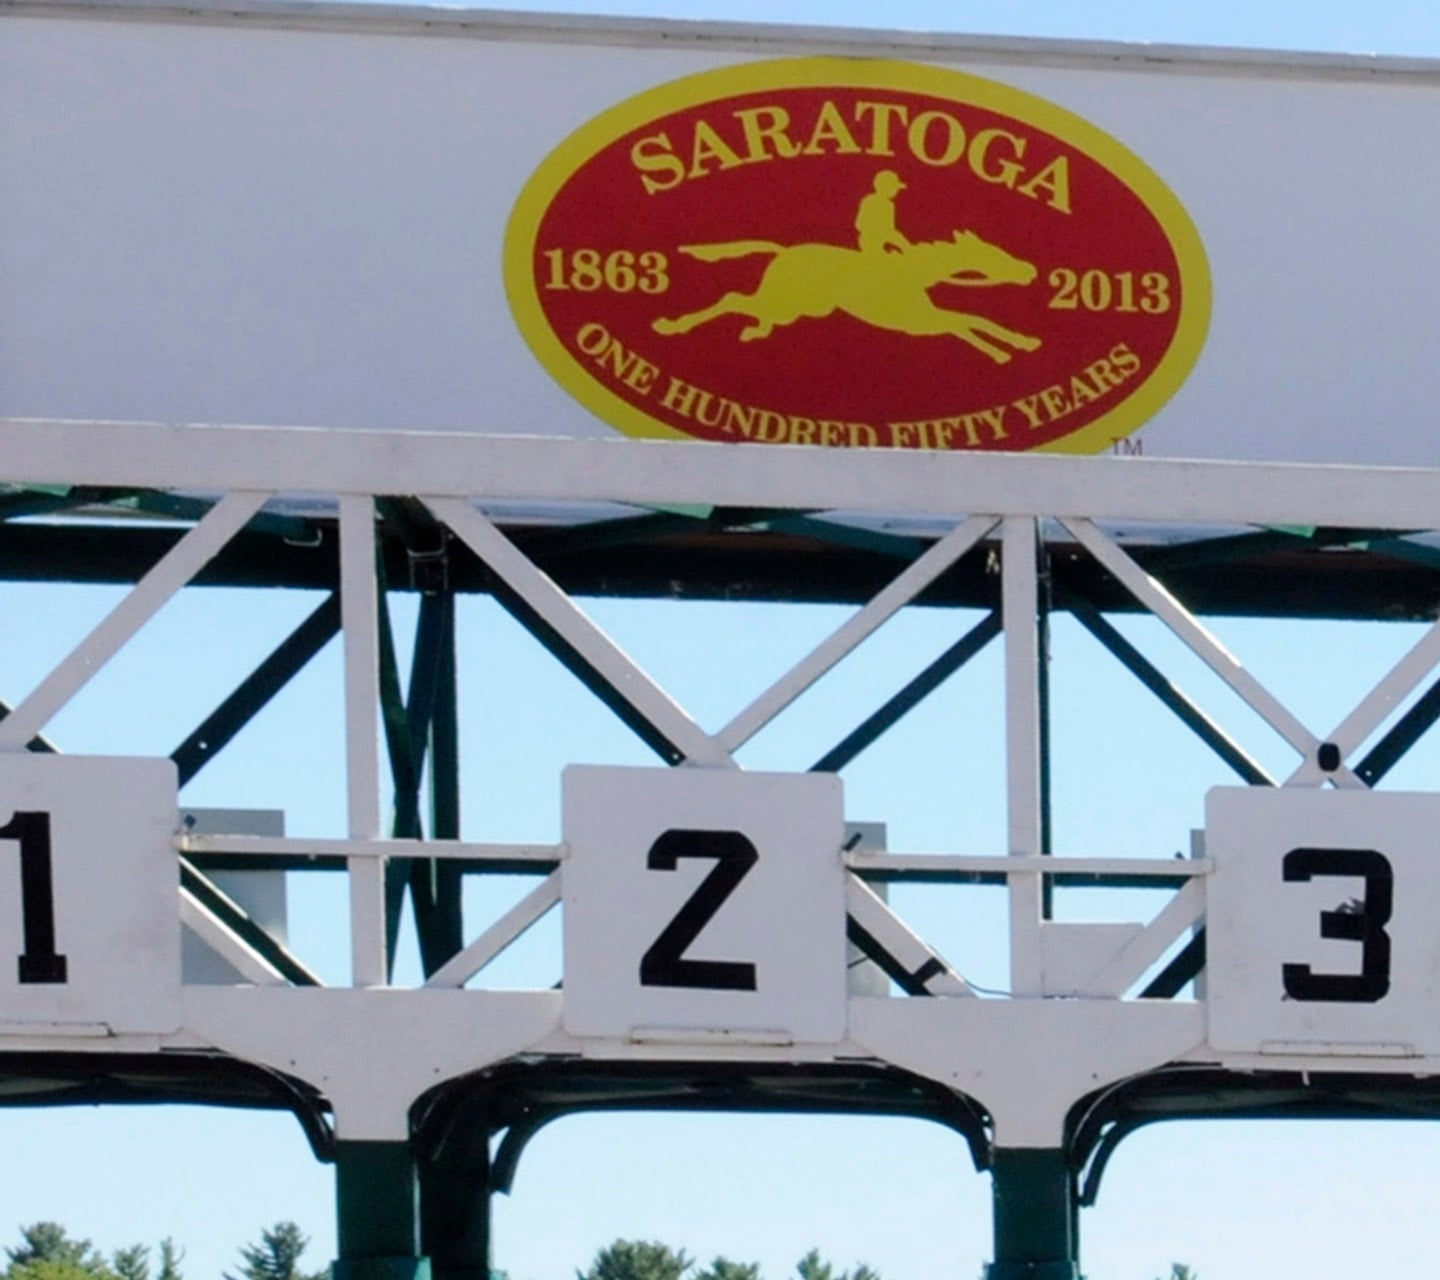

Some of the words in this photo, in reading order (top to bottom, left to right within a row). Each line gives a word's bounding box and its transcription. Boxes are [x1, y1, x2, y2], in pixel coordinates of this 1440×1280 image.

[630, 101, 1073, 214] SARATOGA
[543, 248, 669, 293] 1863
[1047, 268, 1170, 314] 2013
[577, 323, 660, 396] ONE
[661, 377, 878, 447] HUNDRED
[888, 407, 1008, 448] FIFTY
[1013, 342, 1142, 430] YEARS
[0, 811, 68, 985] 1
[639, 828, 759, 992] 2
[1282, 847, 1394, 1003] 3
